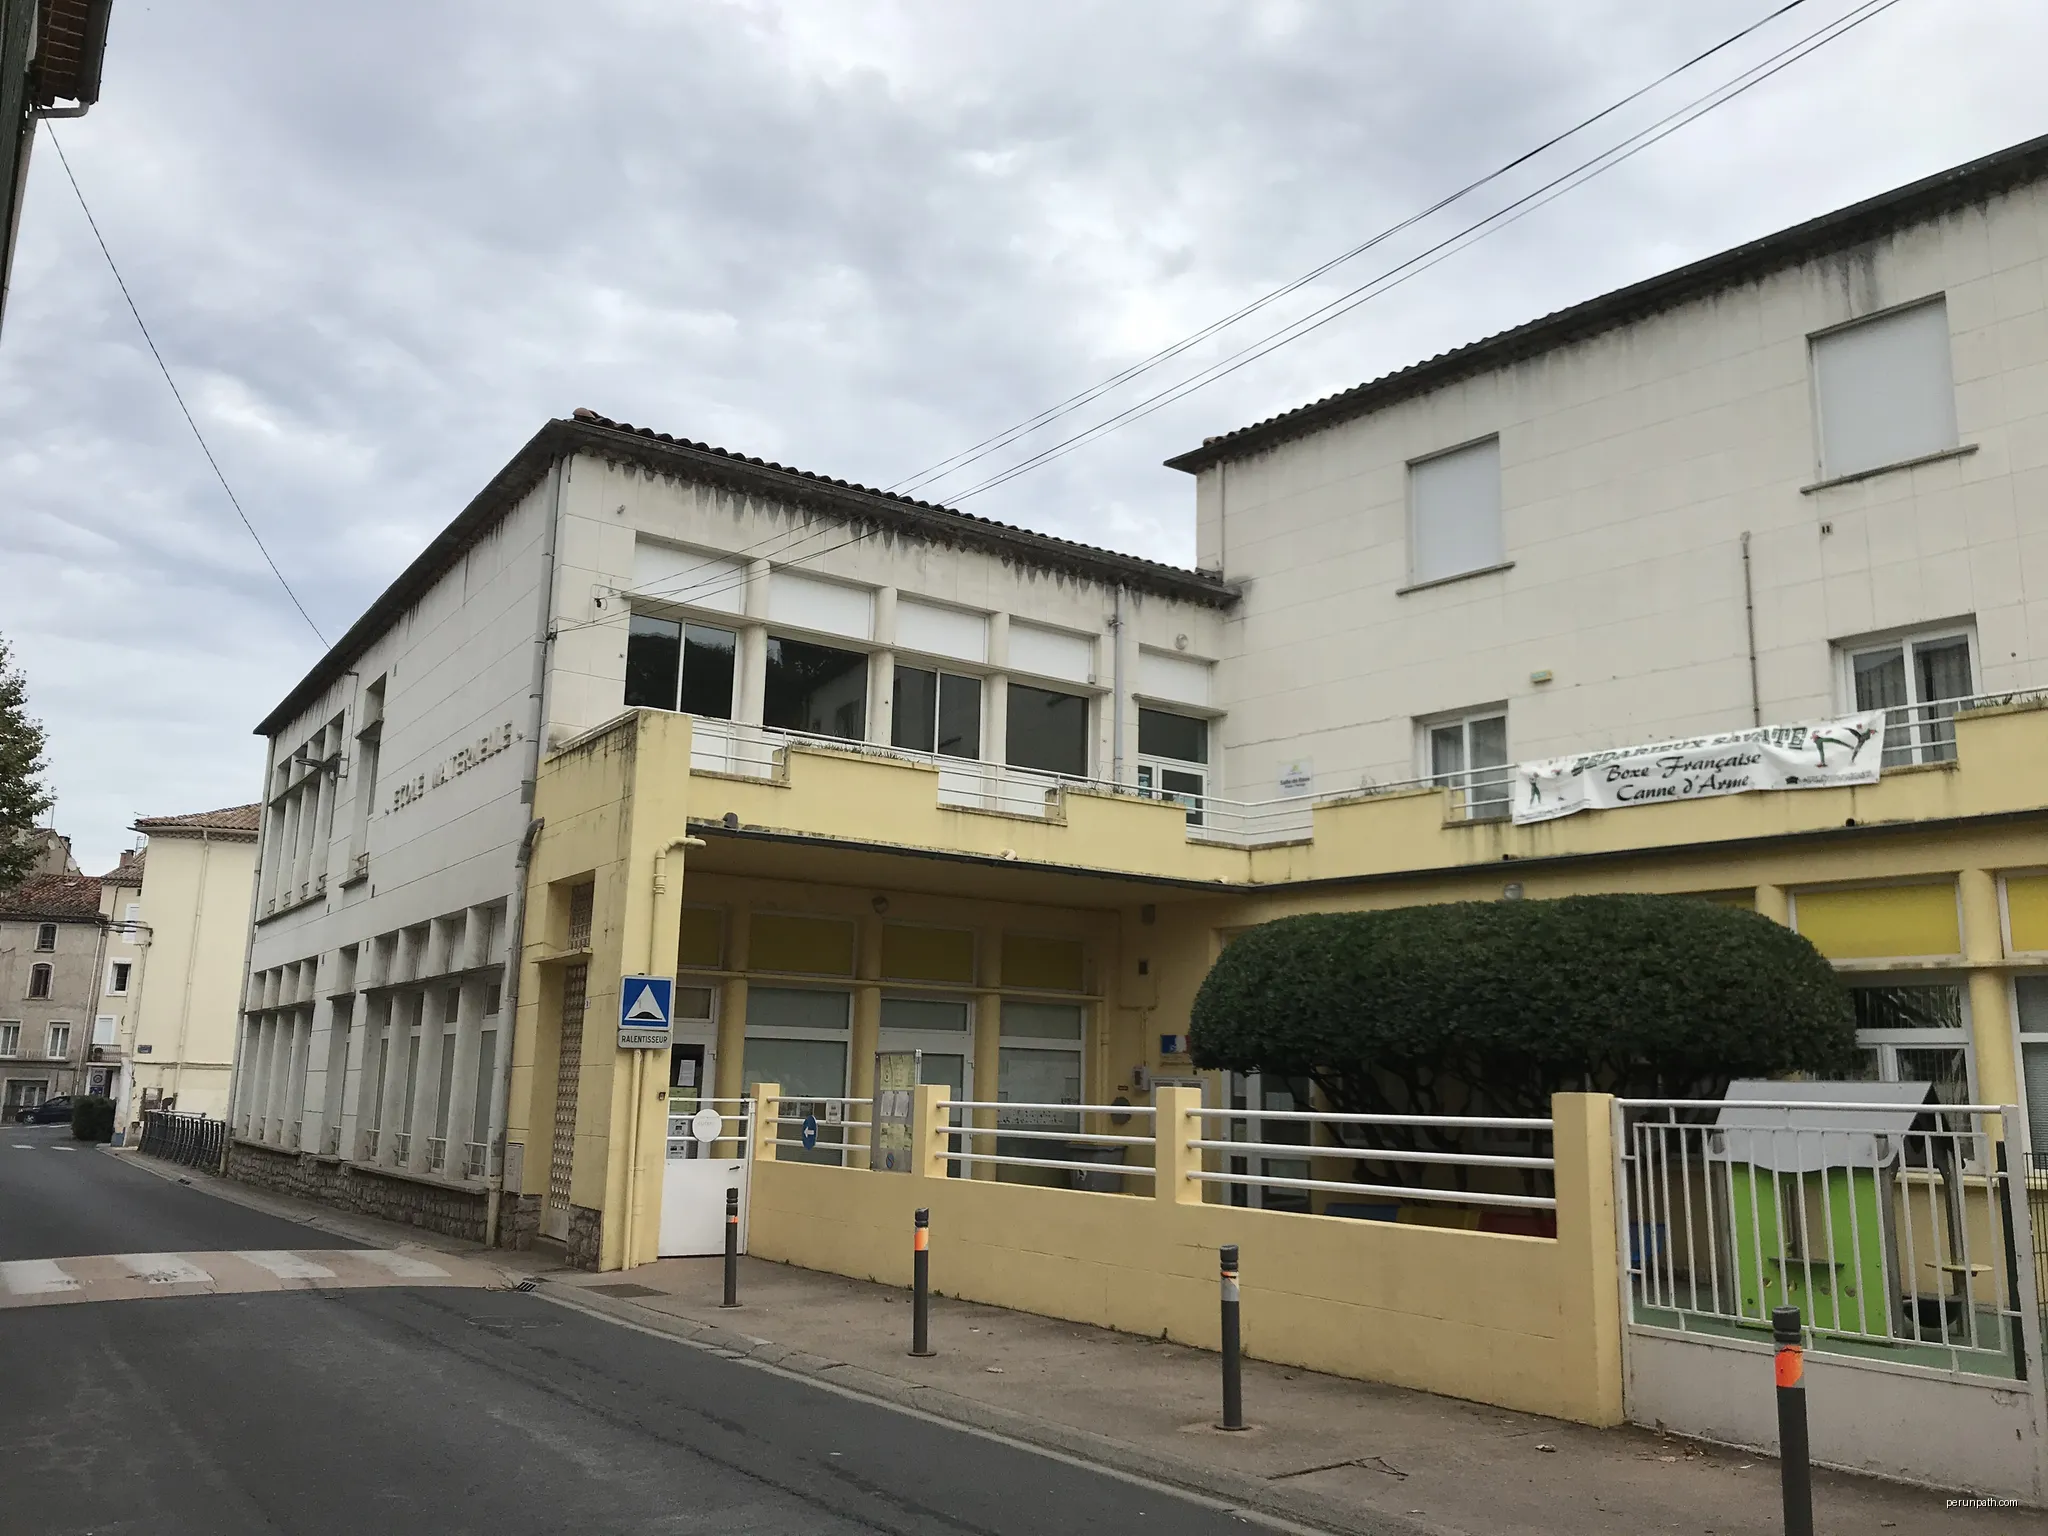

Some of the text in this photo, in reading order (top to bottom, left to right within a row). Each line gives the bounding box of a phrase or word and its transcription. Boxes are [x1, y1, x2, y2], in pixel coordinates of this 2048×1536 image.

[1571, 738, 1707, 777] BEDARIEUX
[1601, 752, 1761, 782] Boxe Française
[1616, 774, 1749, 801] Canne d'Arme
[621, 1035, 668, 1044] RALENTISSEUR
